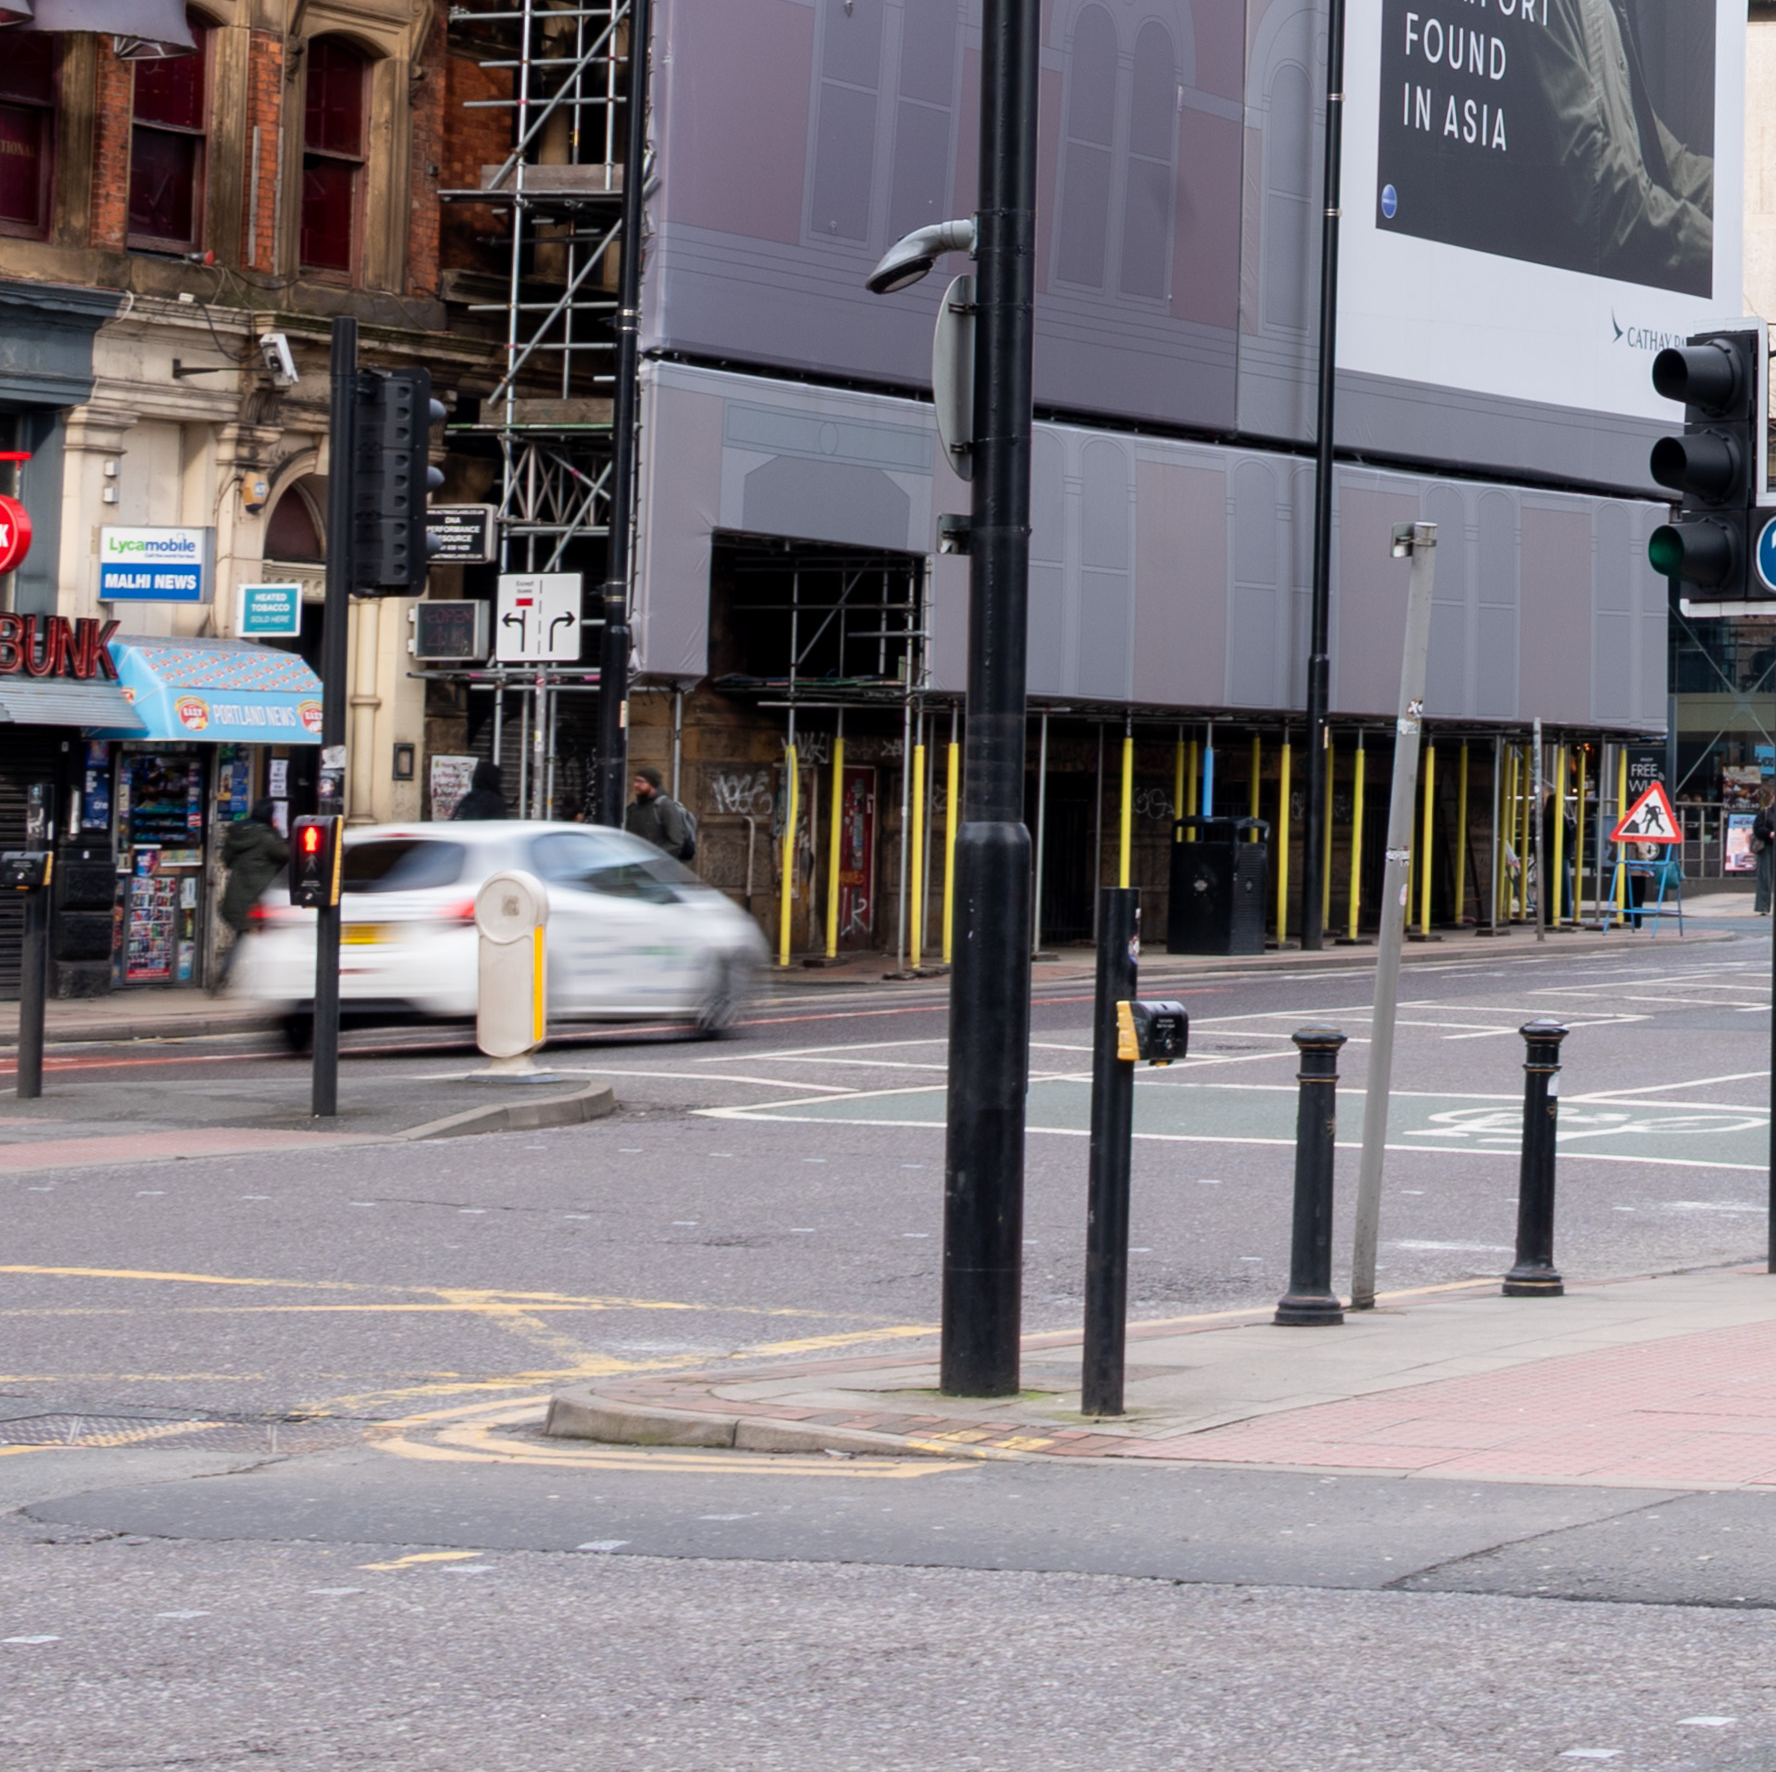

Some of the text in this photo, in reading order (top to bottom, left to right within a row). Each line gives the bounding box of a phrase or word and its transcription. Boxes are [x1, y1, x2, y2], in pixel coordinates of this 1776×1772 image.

[1405, 12, 1507, 81] FOUND
[1403, 82, 1507, 152] IN ASIA
[1627, 327, 1672, 352] CATHAY
[109, 536, 196, 554] Lycamobile
[105, 574, 197, 590] MALHI NEWS
[254, 593, 288, 603] HEATED
[251, 603, 291, 613] TOBACCO
[250, 615, 291, 625] SOLD HERE
[0, 611, 121, 681] BUNK
[213, 704, 297, 728] PORTLAND NEWS
[1631, 763, 1658, 777] FREE
